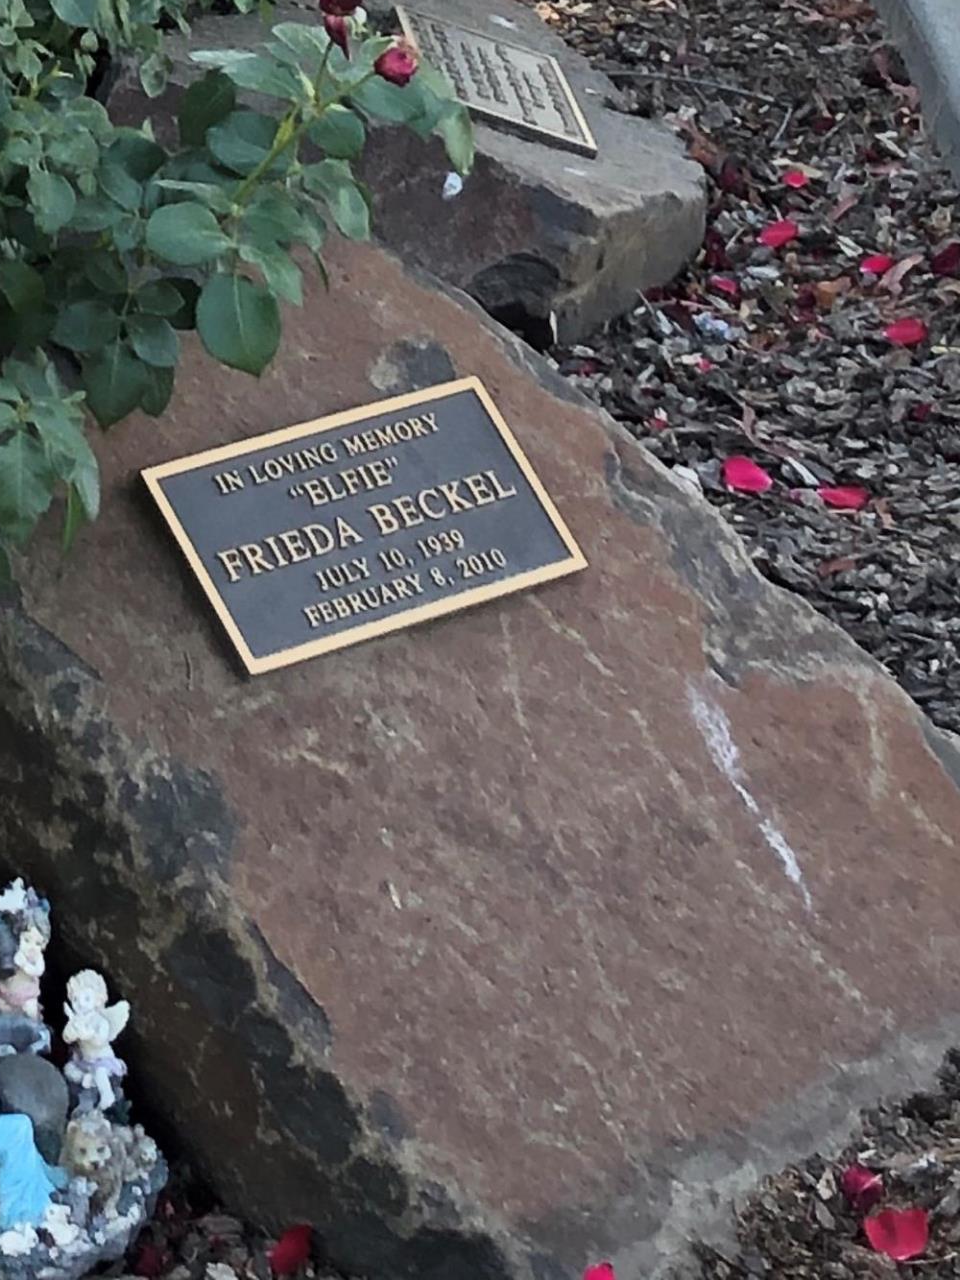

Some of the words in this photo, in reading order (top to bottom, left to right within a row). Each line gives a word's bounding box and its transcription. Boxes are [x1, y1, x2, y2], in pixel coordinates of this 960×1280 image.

[214, 473, 244, 495] IN
[248, 443, 338, 484] LOVING
[342, 412, 440, 457] MEMORY
[216, 516, 364, 583] FRIEDA
[367, 470, 518, 536] BECKEL
[315, 556, 371, 592] JULY
[378, 547, 415, 572] 10,
[417, 528, 465, 560] 1939
[303, 573, 424, 628] FEBRUARY
[431, 566, 456, 588] 8,
[456, 547, 507, 579] 2010
